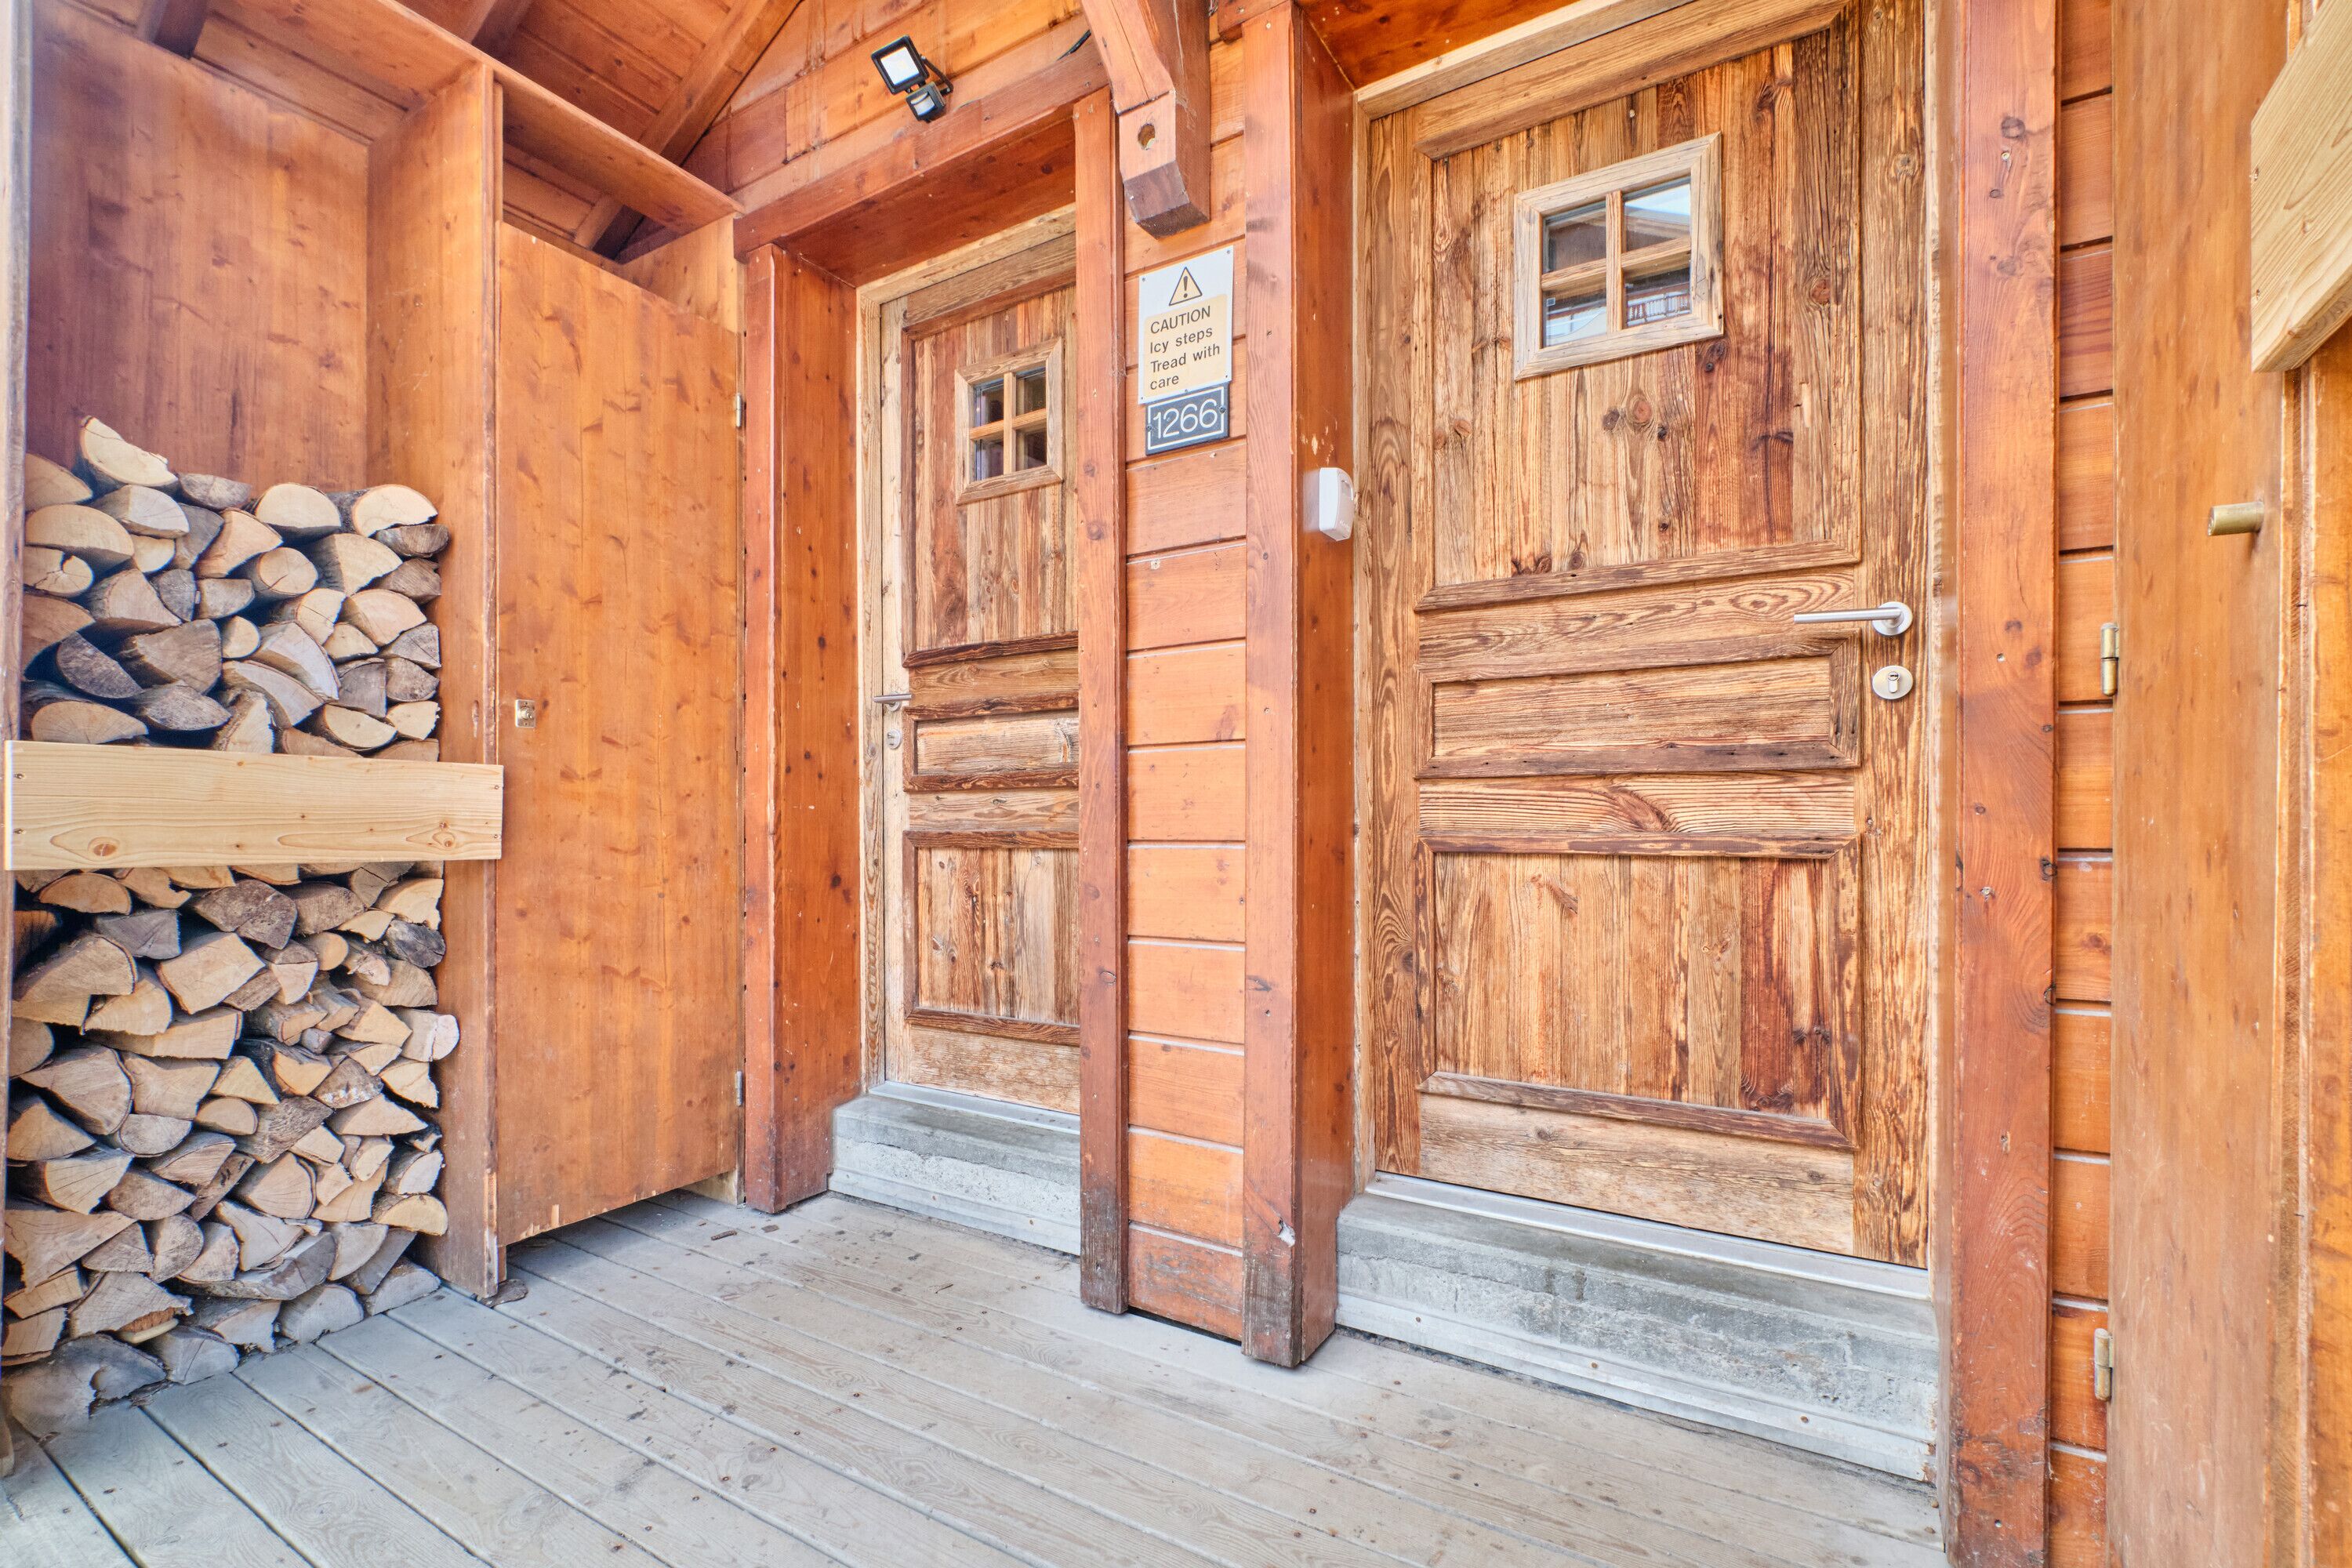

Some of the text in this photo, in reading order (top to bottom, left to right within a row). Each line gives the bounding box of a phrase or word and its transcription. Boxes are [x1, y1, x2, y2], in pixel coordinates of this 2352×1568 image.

[1150, 305, 1211, 334] CAUTION
[1150, 327, 1213, 354] Icy steps
[1150, 343, 1220, 373] Tread with
[1150, 375, 1179, 390] care
[1152, 398, 1218, 439] 1266
